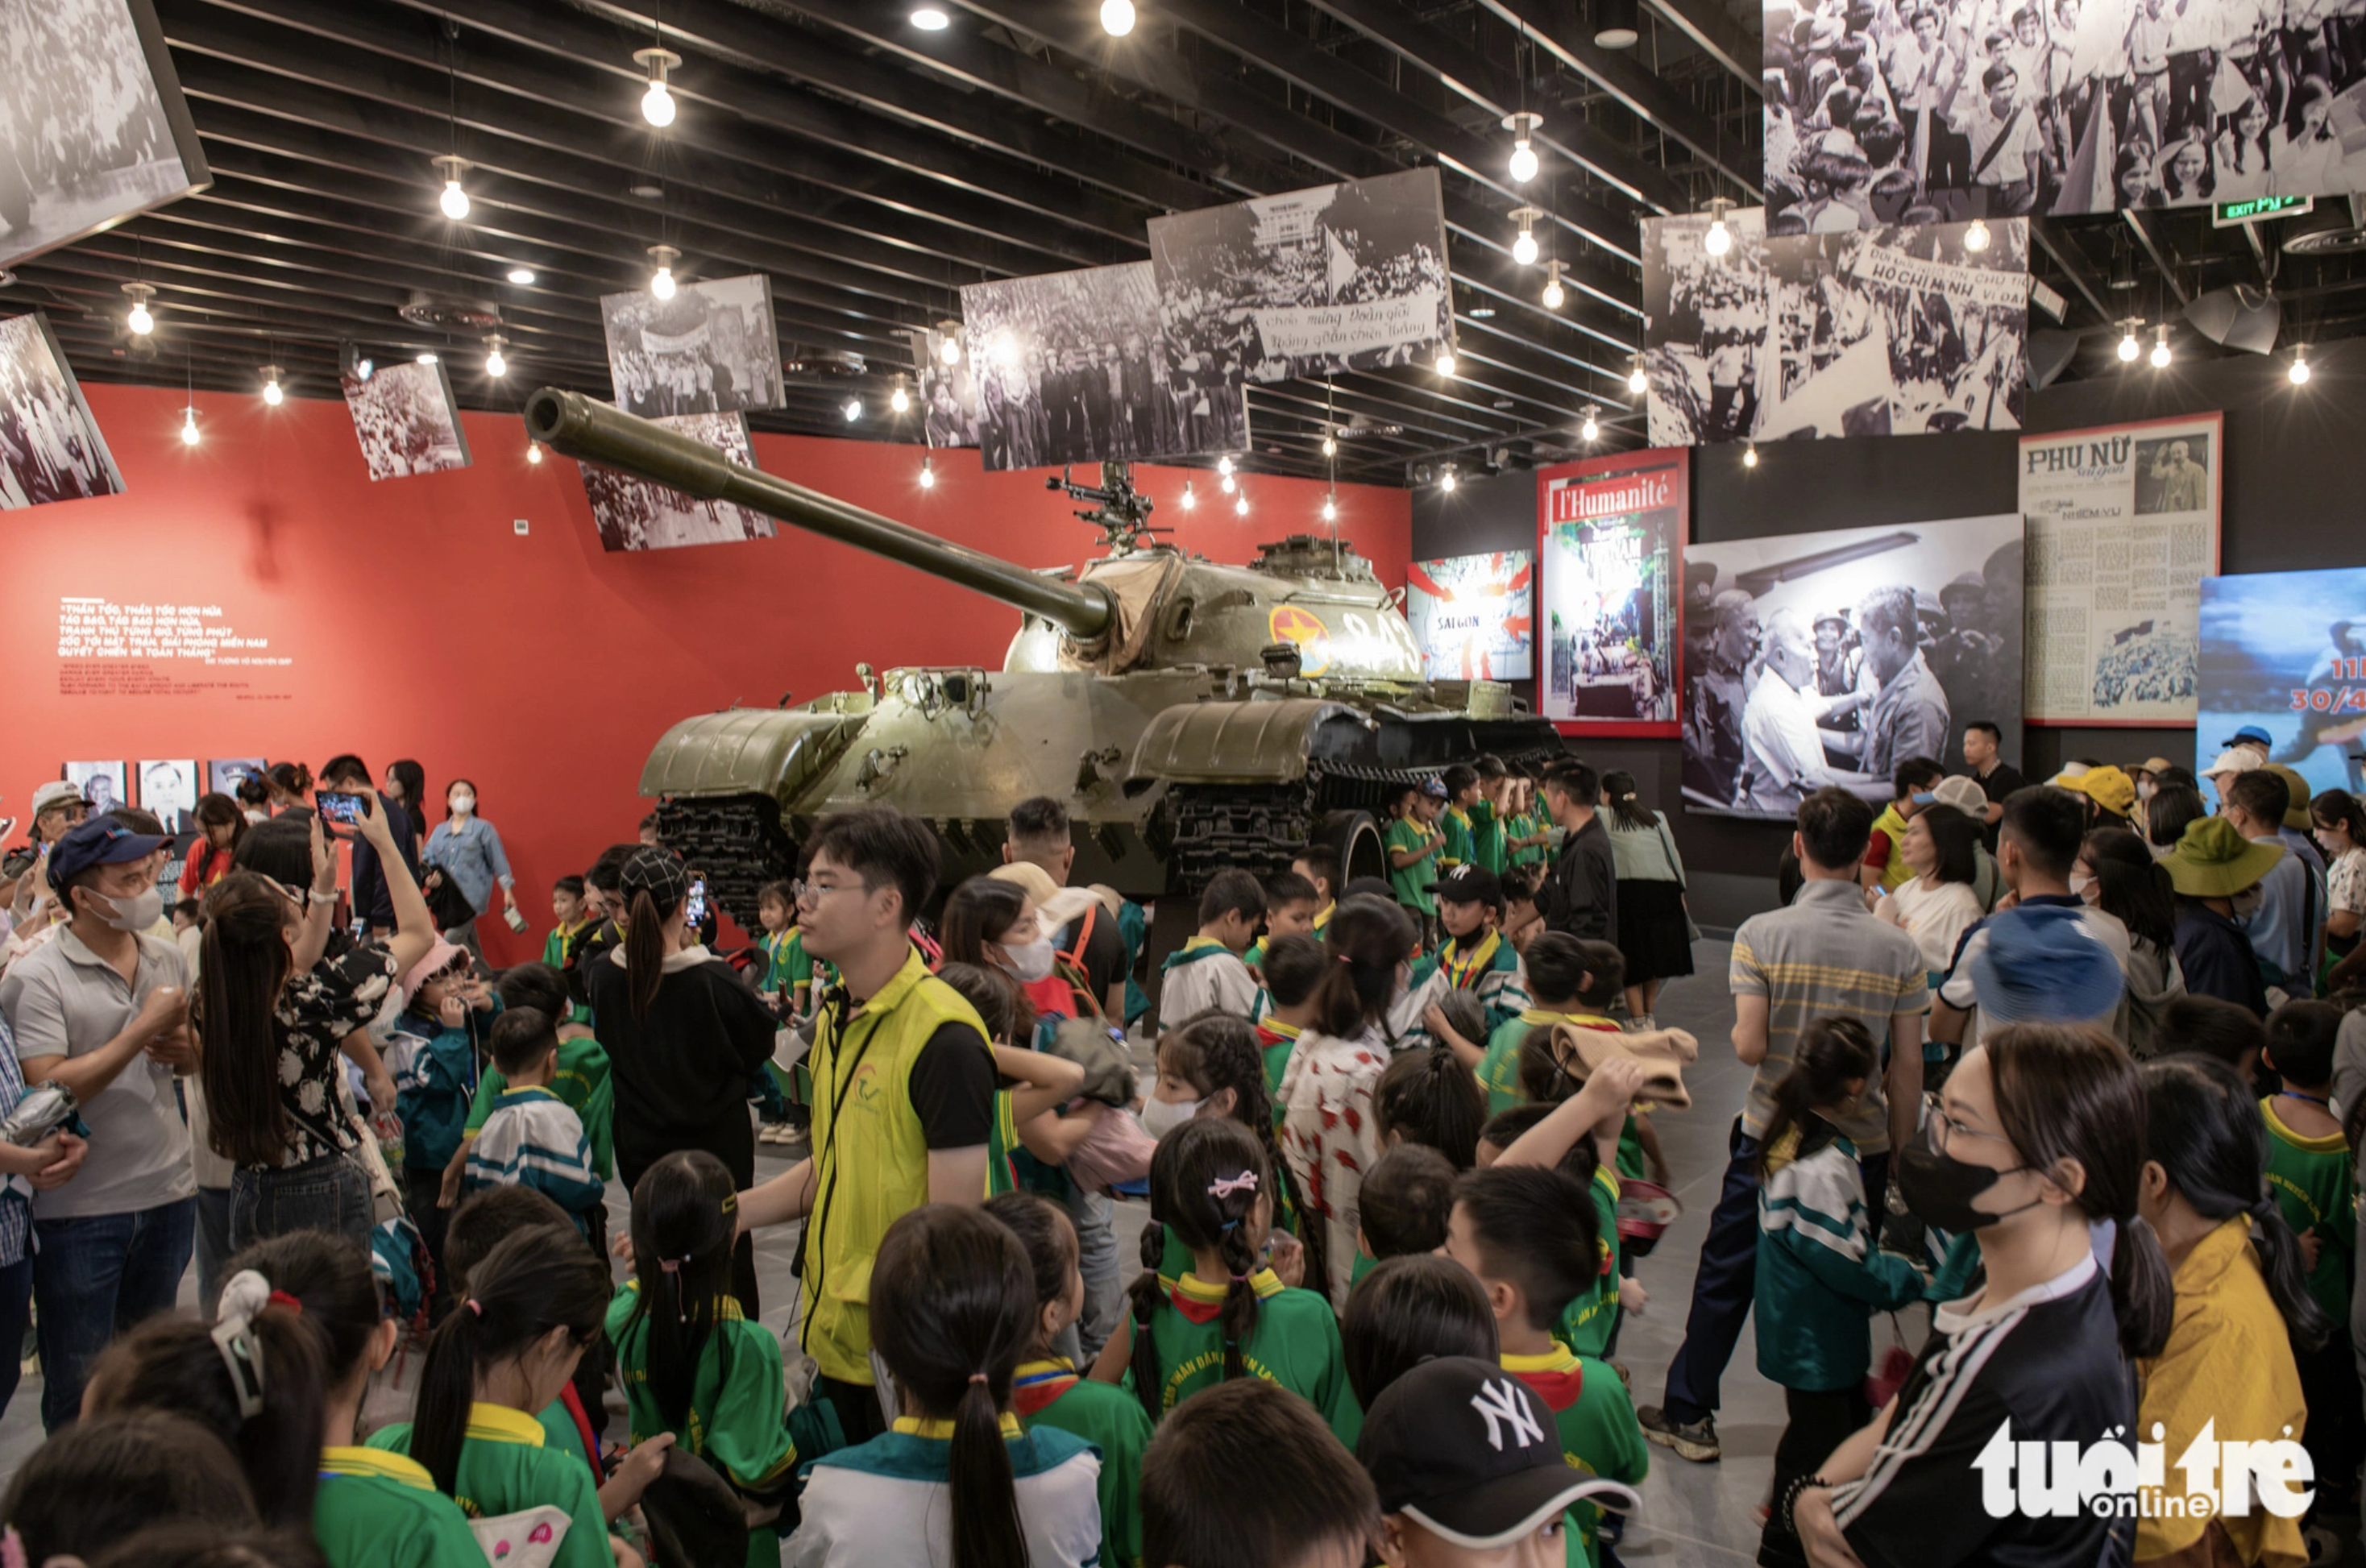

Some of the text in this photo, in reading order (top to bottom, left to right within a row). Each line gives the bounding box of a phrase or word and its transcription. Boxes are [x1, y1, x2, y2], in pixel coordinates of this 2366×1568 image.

[2227, 201, 2256, 218] EXIT
[1437, 615, 1480, 631] SAIGON
[1470, 1377, 1545, 1452] NY
